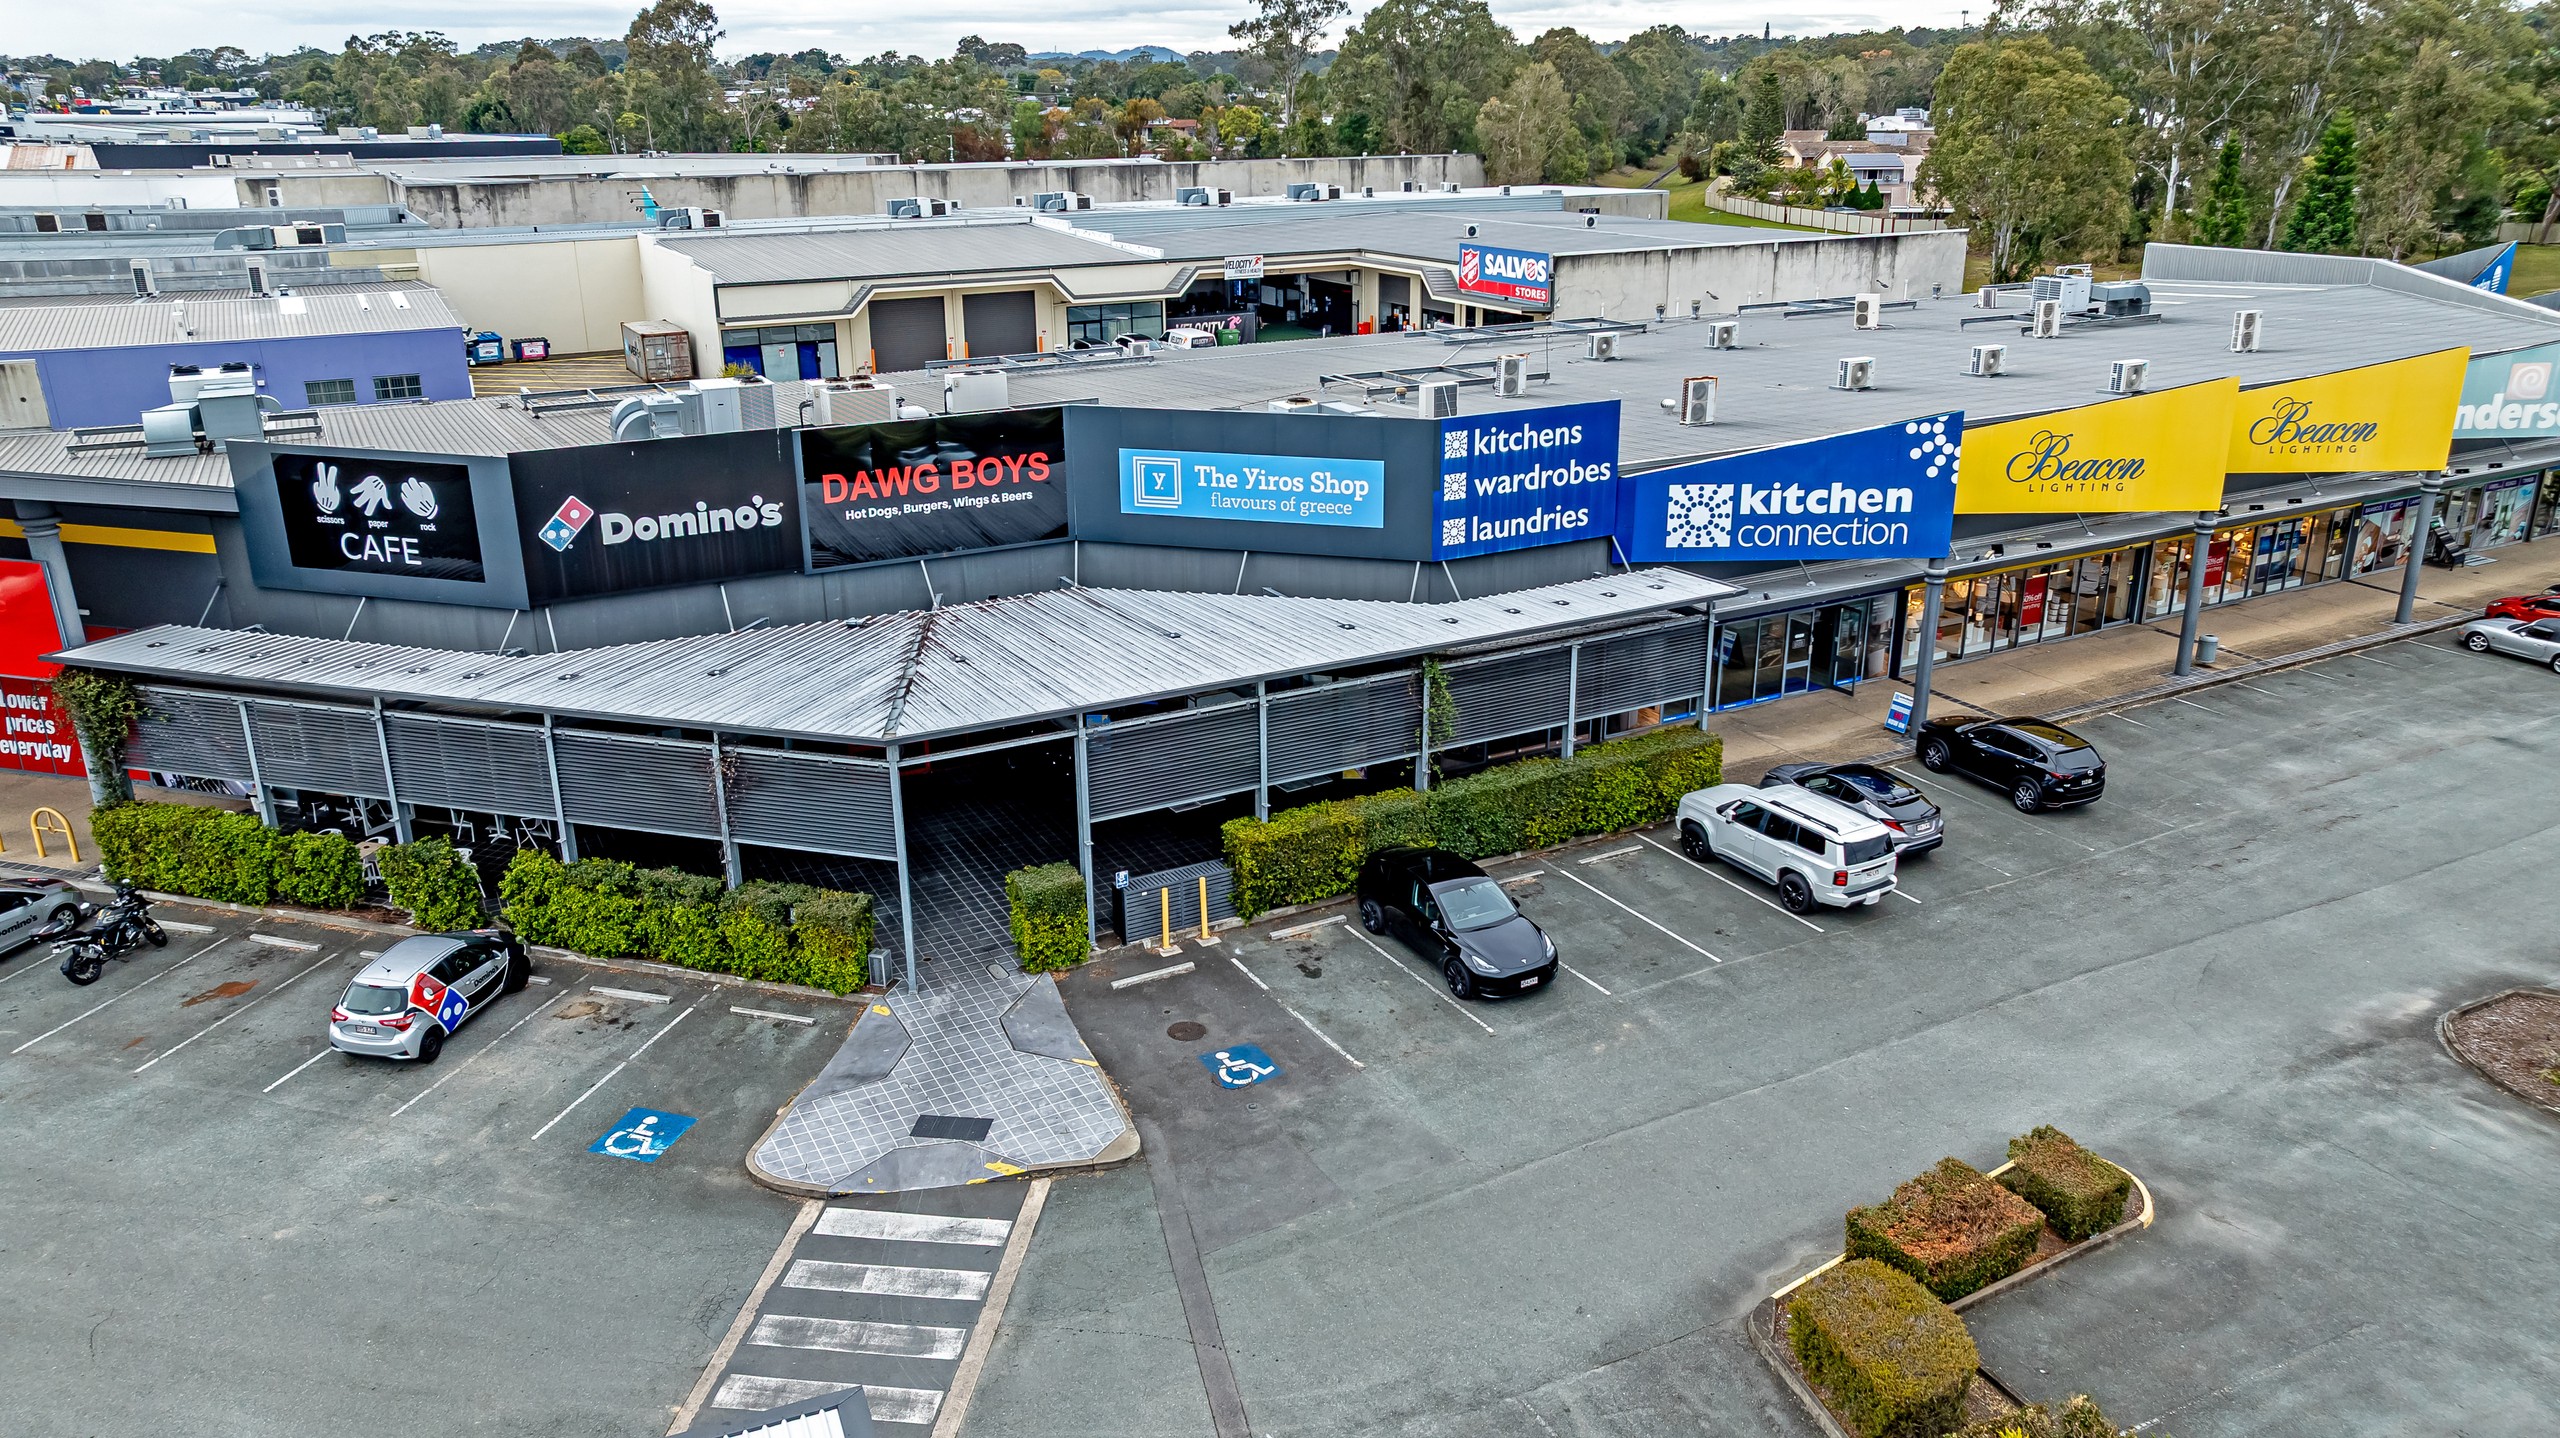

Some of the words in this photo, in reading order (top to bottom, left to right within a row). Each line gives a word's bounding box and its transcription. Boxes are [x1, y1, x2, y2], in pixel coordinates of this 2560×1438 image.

[1225, 259, 1252, 270] VELOCITY
[1484, 253, 1547, 283] SALVOS
[1515, 286, 1546, 300] STORES
[2249, 396, 2378, 445] Beacon
[1474, 423, 1583, 456] kitchens
[2269, 444, 2358, 454] LIGHTING
[2006, 429, 2146, 483] Beacon
[821, 463, 941, 504] DAWG
[950, 451, 1051, 491] BOYS
[1194, 464, 1238, 488] The
[1310, 471, 1370, 502] Shop
[1473, 458, 1611, 497] wardrobes
[2028, 482, 2124, 493] LIGHTING
[845, 508, 868, 521] Hot
[868, 505, 902, 519] Dogs,
[903, 498, 952, 515] Burgers,
[953, 494, 990, 508] Wings
[990, 493, 1001, 505] &
[1001, 490, 1033, 503] Beers
[1210, 492, 1277, 512] flavours
[1280, 496, 1297, 512] of
[1299, 500, 1353, 517] greece
[1739, 481, 1914, 515] kitchen
[316, 515, 345, 525] scissors
[367, 519, 389, 529] paper
[420, 522, 437, 532] rock
[599, 494, 783, 546] Domino's
[1472, 504, 1589, 542] laundries
[1737, 516, 1909, 547] connection
[340, 532, 423, 566] CAFE
[5, 714, 56, 735] prices
[0, 738, 73, 763] everyday
[0, 914, 38, 937] omino's
[474, 964, 499, 988] Domino's
